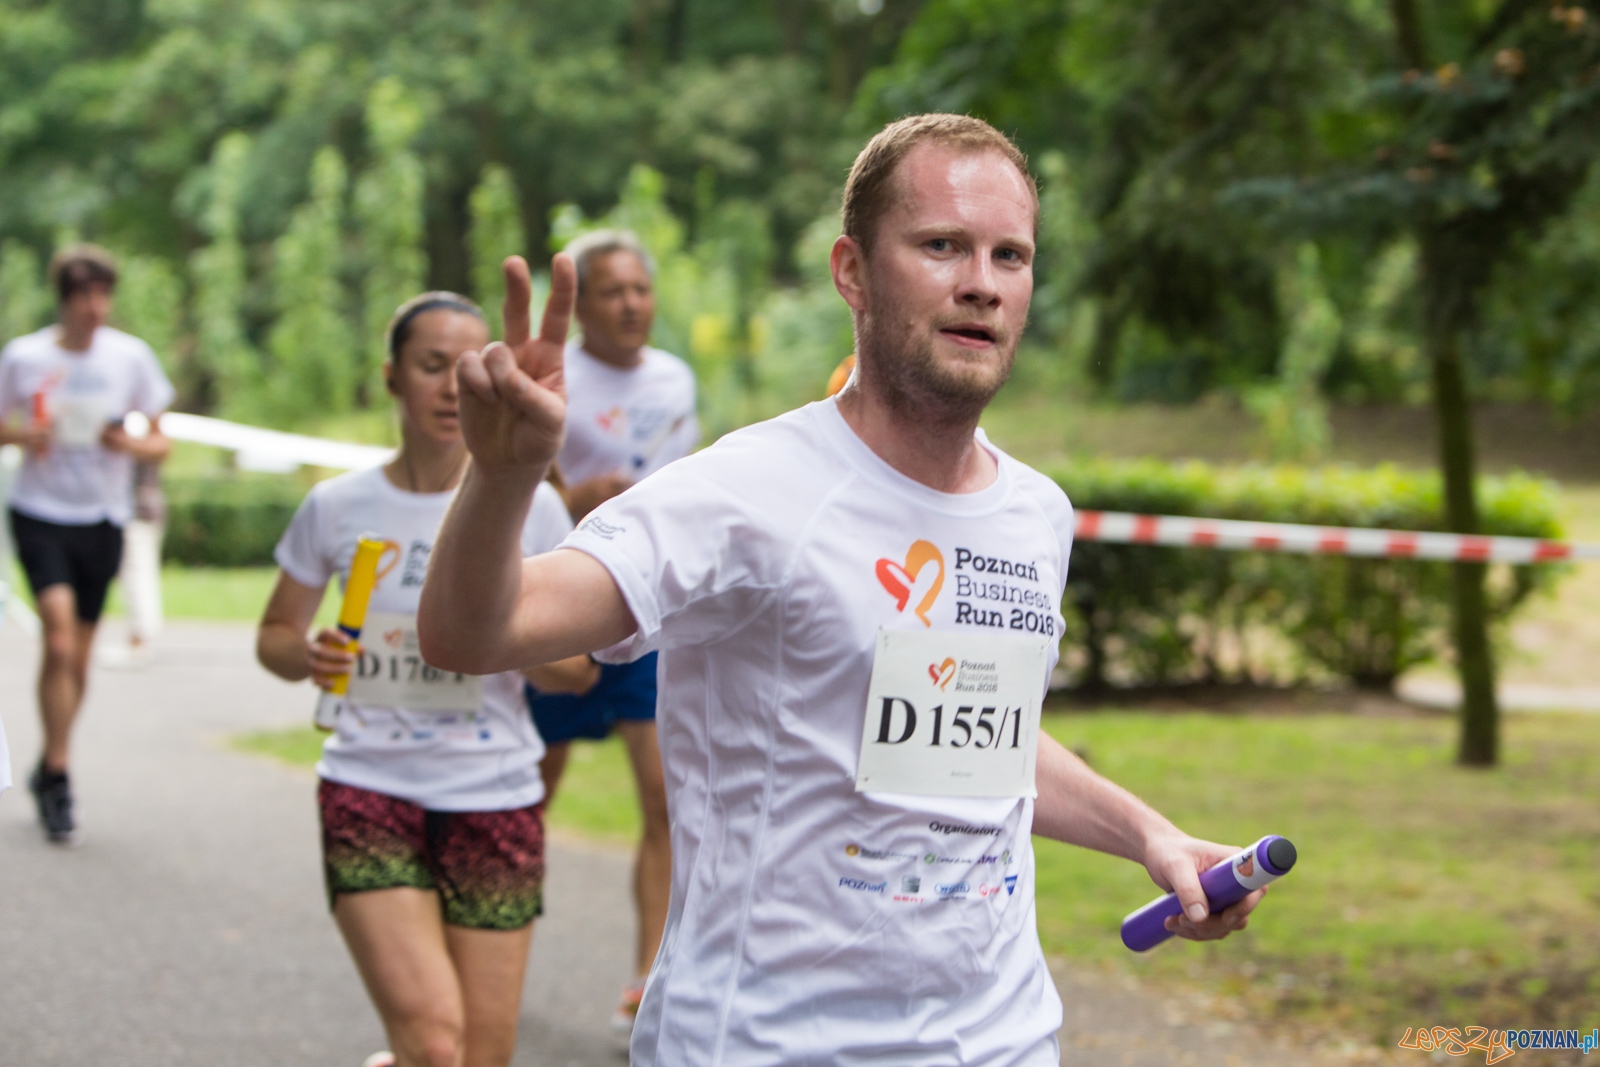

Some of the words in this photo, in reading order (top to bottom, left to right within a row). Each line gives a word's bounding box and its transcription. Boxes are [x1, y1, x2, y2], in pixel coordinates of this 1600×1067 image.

[954, 547, 1040, 582] Poznań
[954, 575, 1052, 611] Business
[954, 601, 1004, 628] Run
[1009, 608, 1054, 637] 2016
[357, 650, 381, 678] D
[955, 681, 975, 692] Run
[872, 696, 917, 744] D
[926, 703, 1022, 750] 155/1
